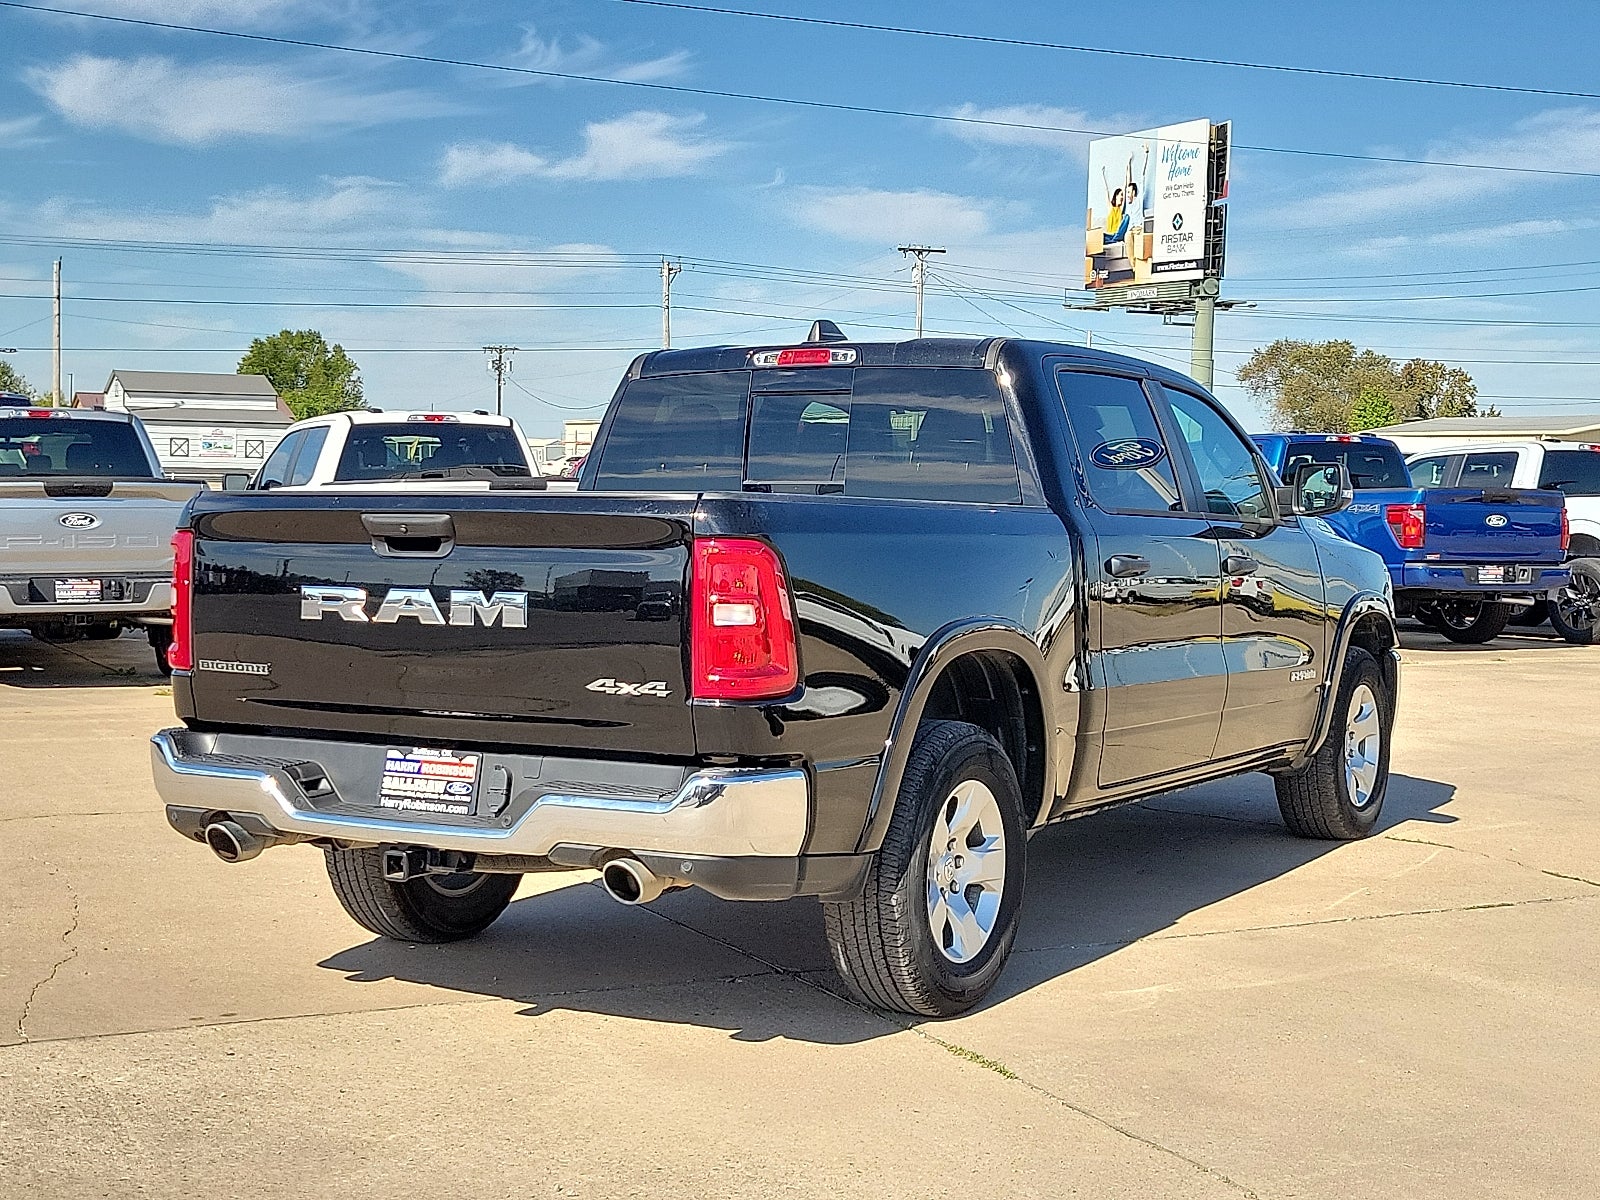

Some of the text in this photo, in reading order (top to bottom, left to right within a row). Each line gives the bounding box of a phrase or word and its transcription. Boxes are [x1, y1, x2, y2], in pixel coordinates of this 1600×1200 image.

[1162, 143, 1200, 163] Welcome
[1168, 162, 1192, 181] Home
[1160, 232, 1194, 244] FIRSTAR
[1167, 243, 1187, 254] BANK
[64, 513, 93, 528] Ford
[301, 585, 528, 628] RAM
[386, 760, 475, 778] HARRY ROBINSON
[380, 796, 469, 815] HarryRobinson.com
